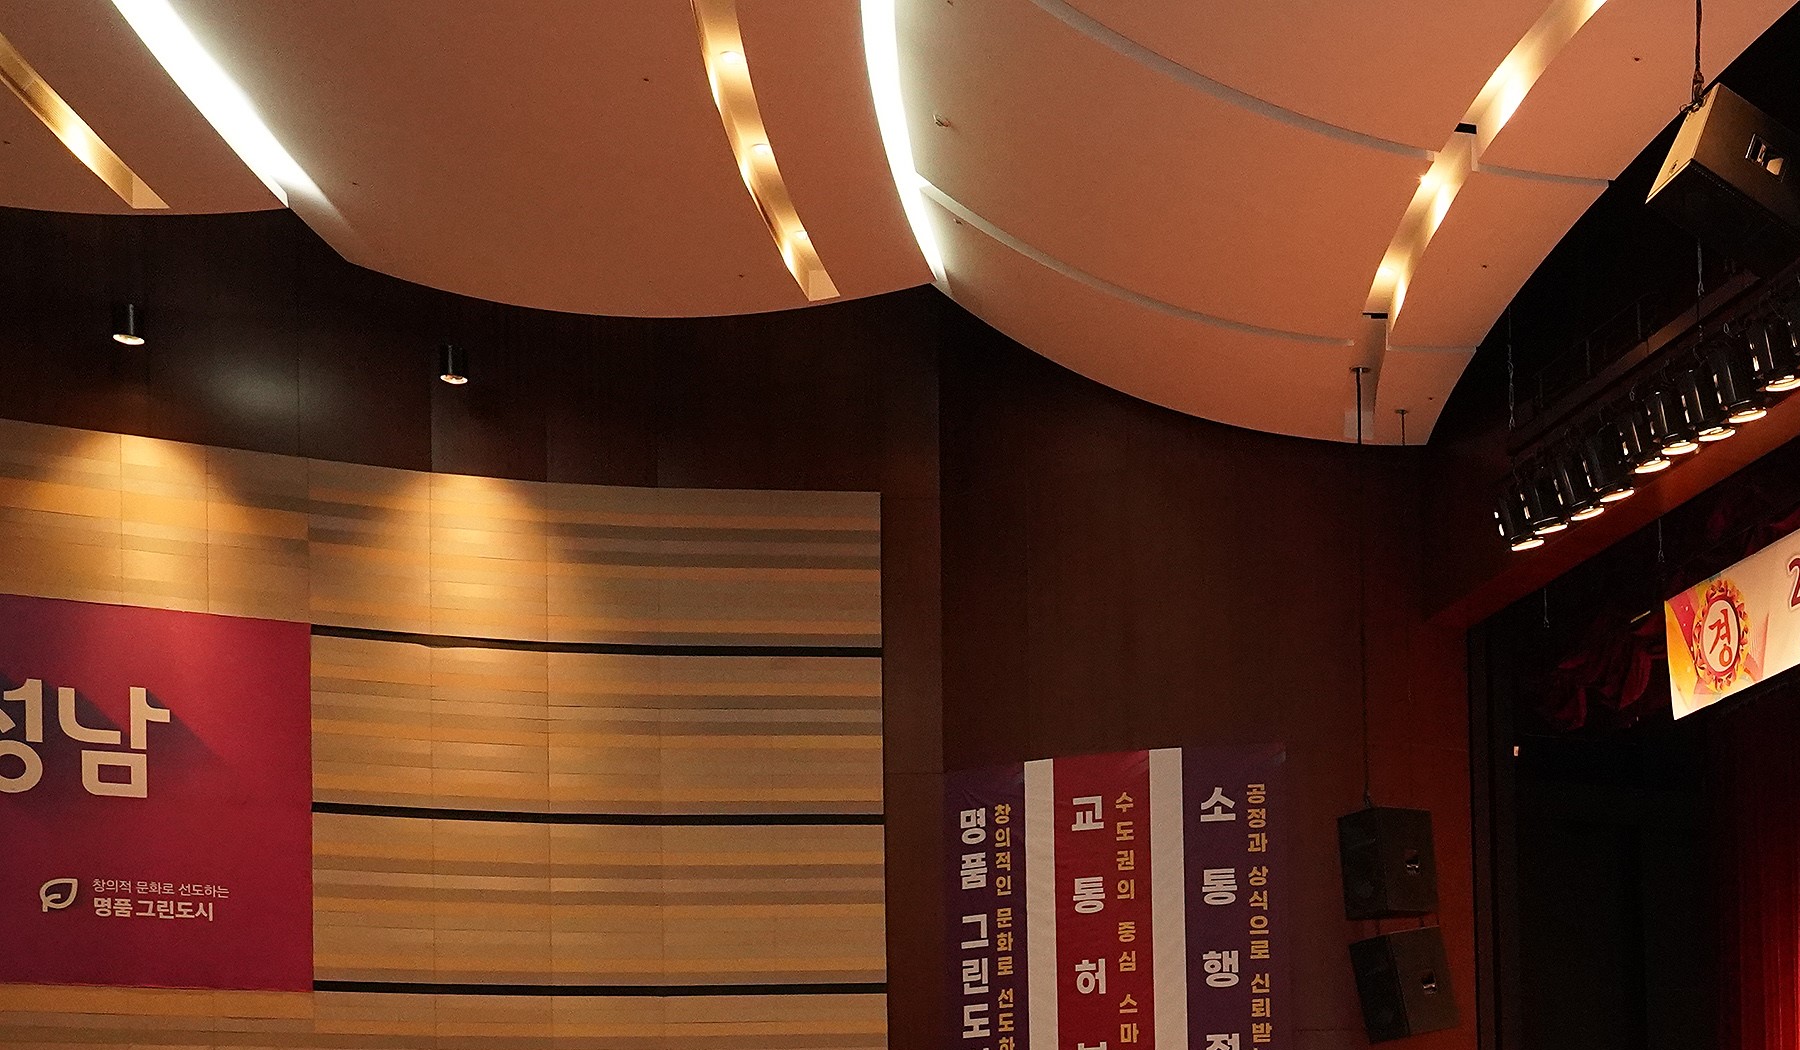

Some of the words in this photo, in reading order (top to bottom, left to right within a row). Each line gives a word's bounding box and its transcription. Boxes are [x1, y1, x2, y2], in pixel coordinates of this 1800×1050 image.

[1707, 608, 1735, 668] 경
[960, 807, 988, 890] 명품
[994, 804, 1012, 896] 창의적인
[1115, 792, 1136, 900] 수도권의
[1246, 783, 1268, 853] 공정과
[92, 878, 132, 894] 창의적
[136, 880, 175, 897] 문화로
[178, 882, 230, 899] 선도하는
[93, 897, 133, 918] 명품
[135, 899, 214, 922] 그린도시
[1248, 866, 1271, 961] 상식으로
[996, 907, 1013, 977] 문화로
[1117, 921, 1137, 973] 중심
